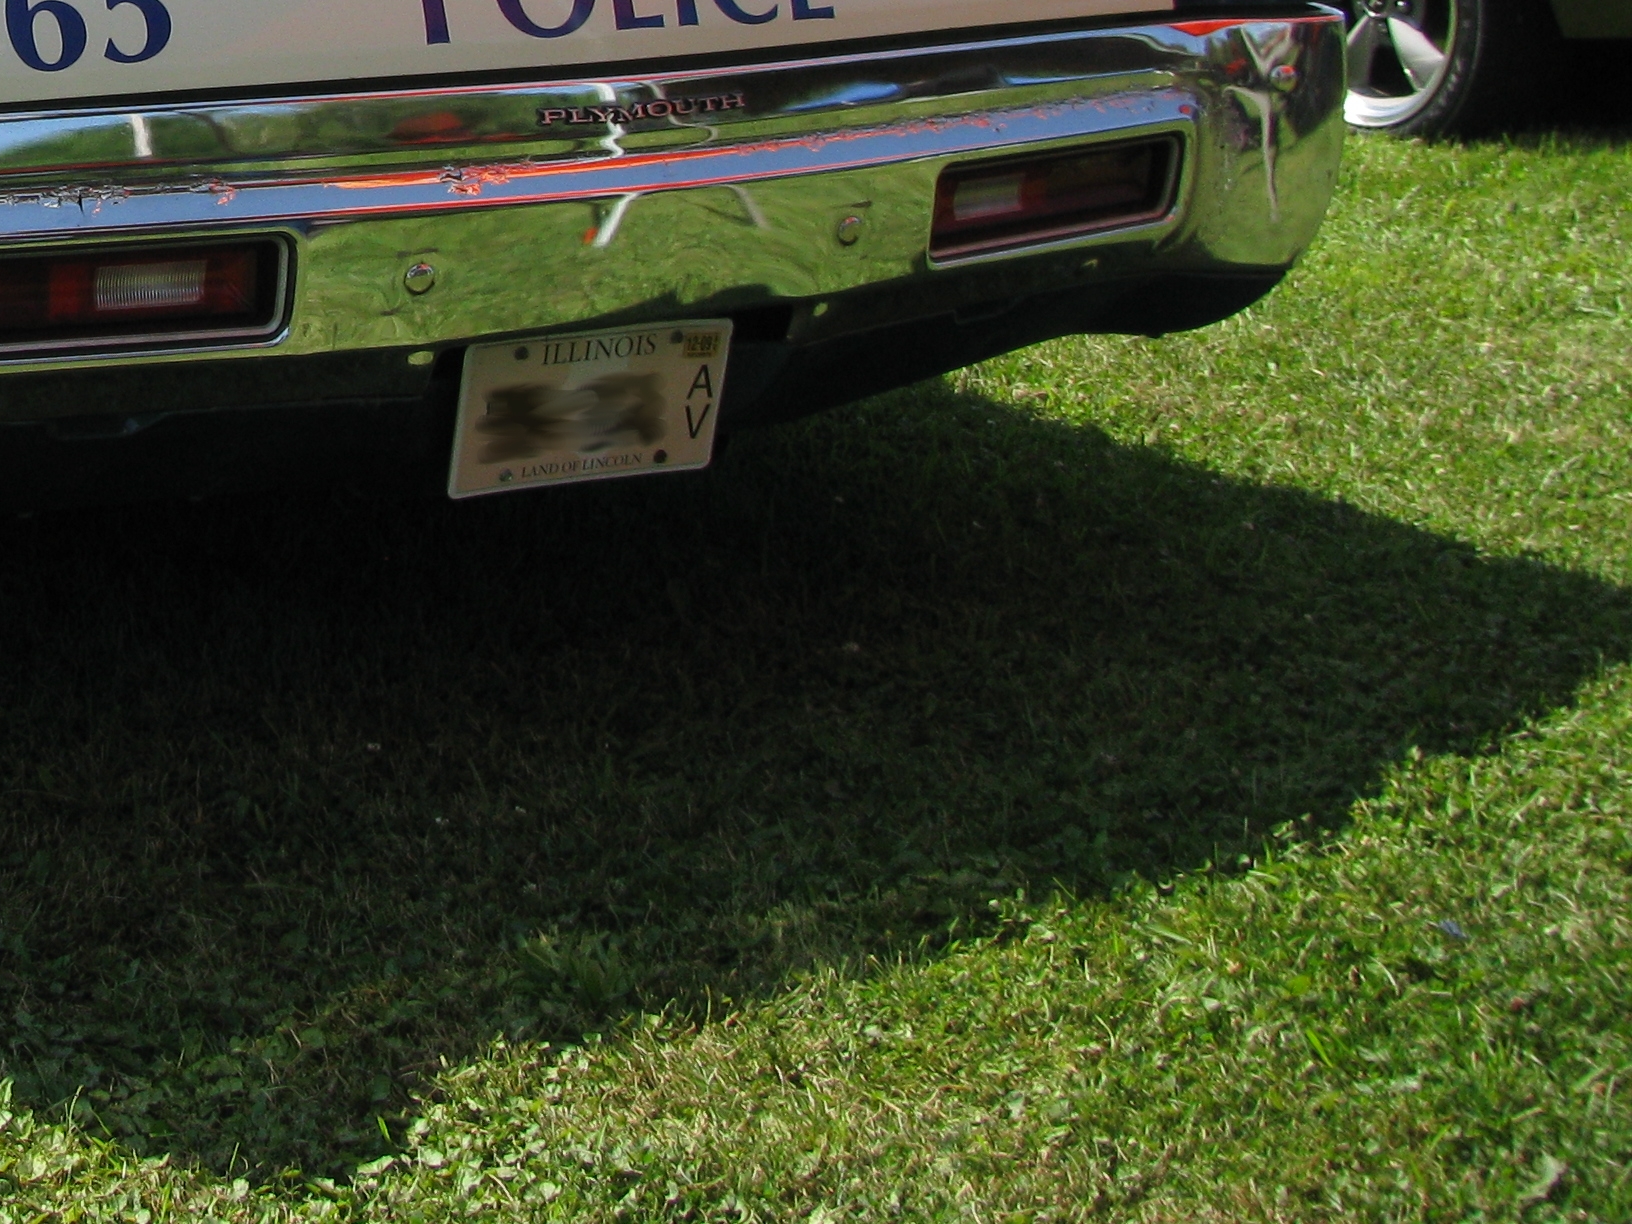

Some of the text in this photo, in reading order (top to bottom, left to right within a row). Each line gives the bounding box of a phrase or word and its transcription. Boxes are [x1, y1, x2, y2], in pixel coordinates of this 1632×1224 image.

[541, 92, 746, 126] PLYMOUTH
[541, 333, 657, 365] ILLINOIS
[521, 452, 643, 478] LAND OF LINCOLN
